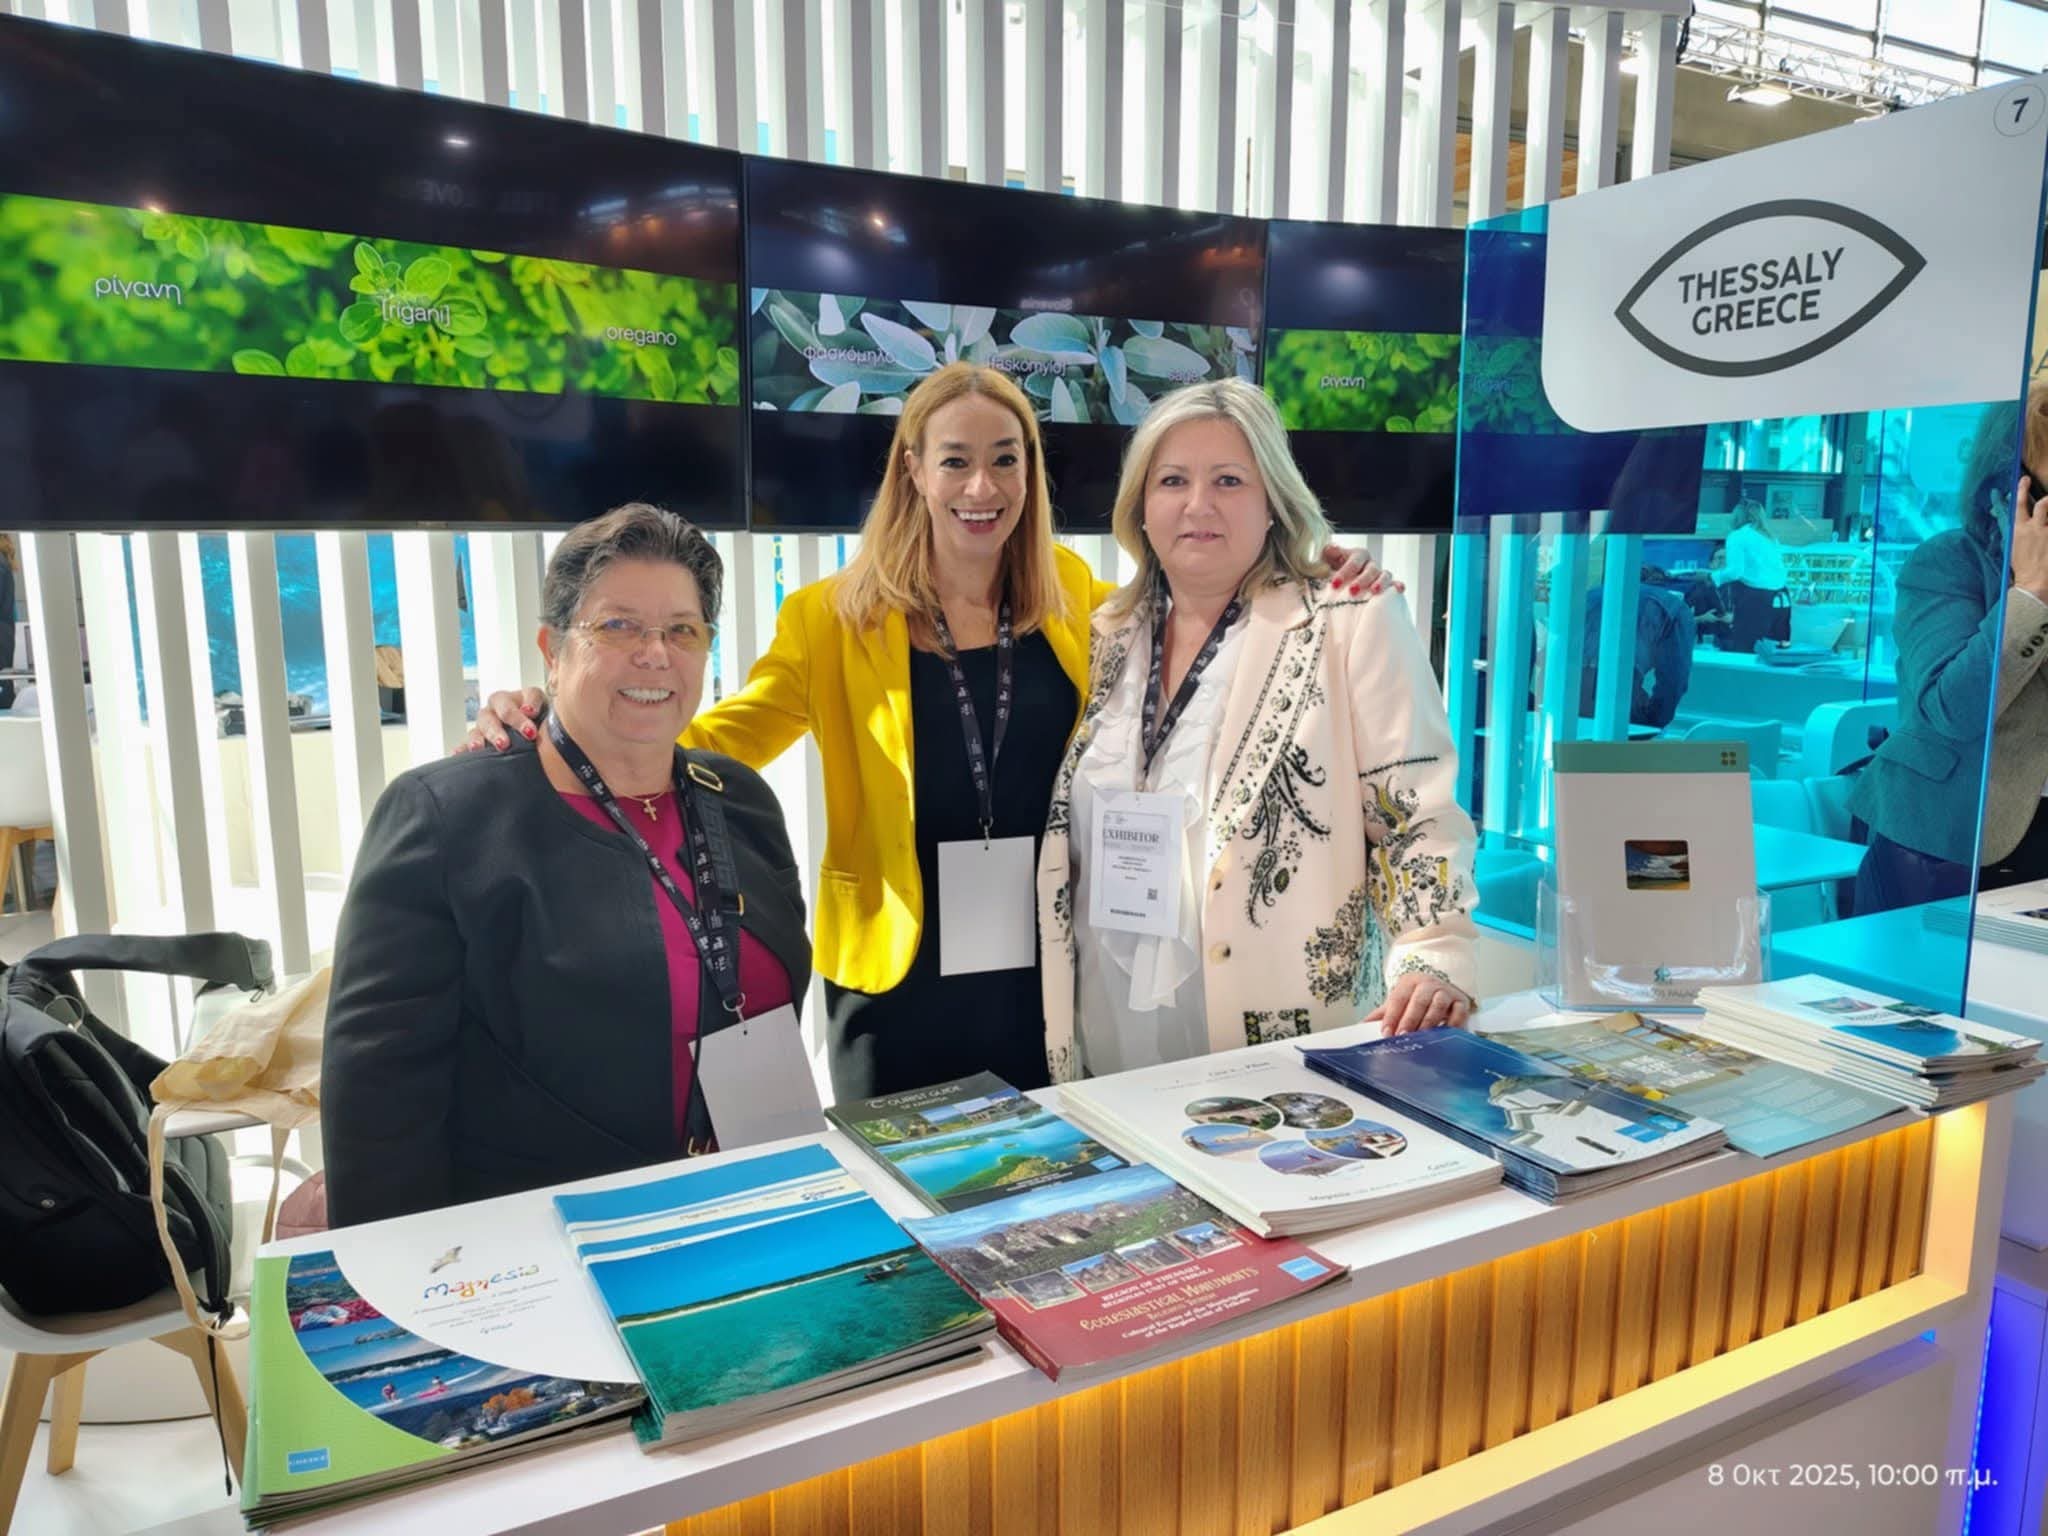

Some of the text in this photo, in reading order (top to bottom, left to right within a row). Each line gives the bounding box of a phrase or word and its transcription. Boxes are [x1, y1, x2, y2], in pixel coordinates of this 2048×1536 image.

[2013, 98, 2029, 123] 7
[95, 274, 182, 305] ρίγανη
[1678, 247, 1845, 304] THESSALY
[1692, 289, 1821, 336] GREECE
[606, 324, 677, 346] oregano
[1320, 375, 1366, 390] ρίγανη
